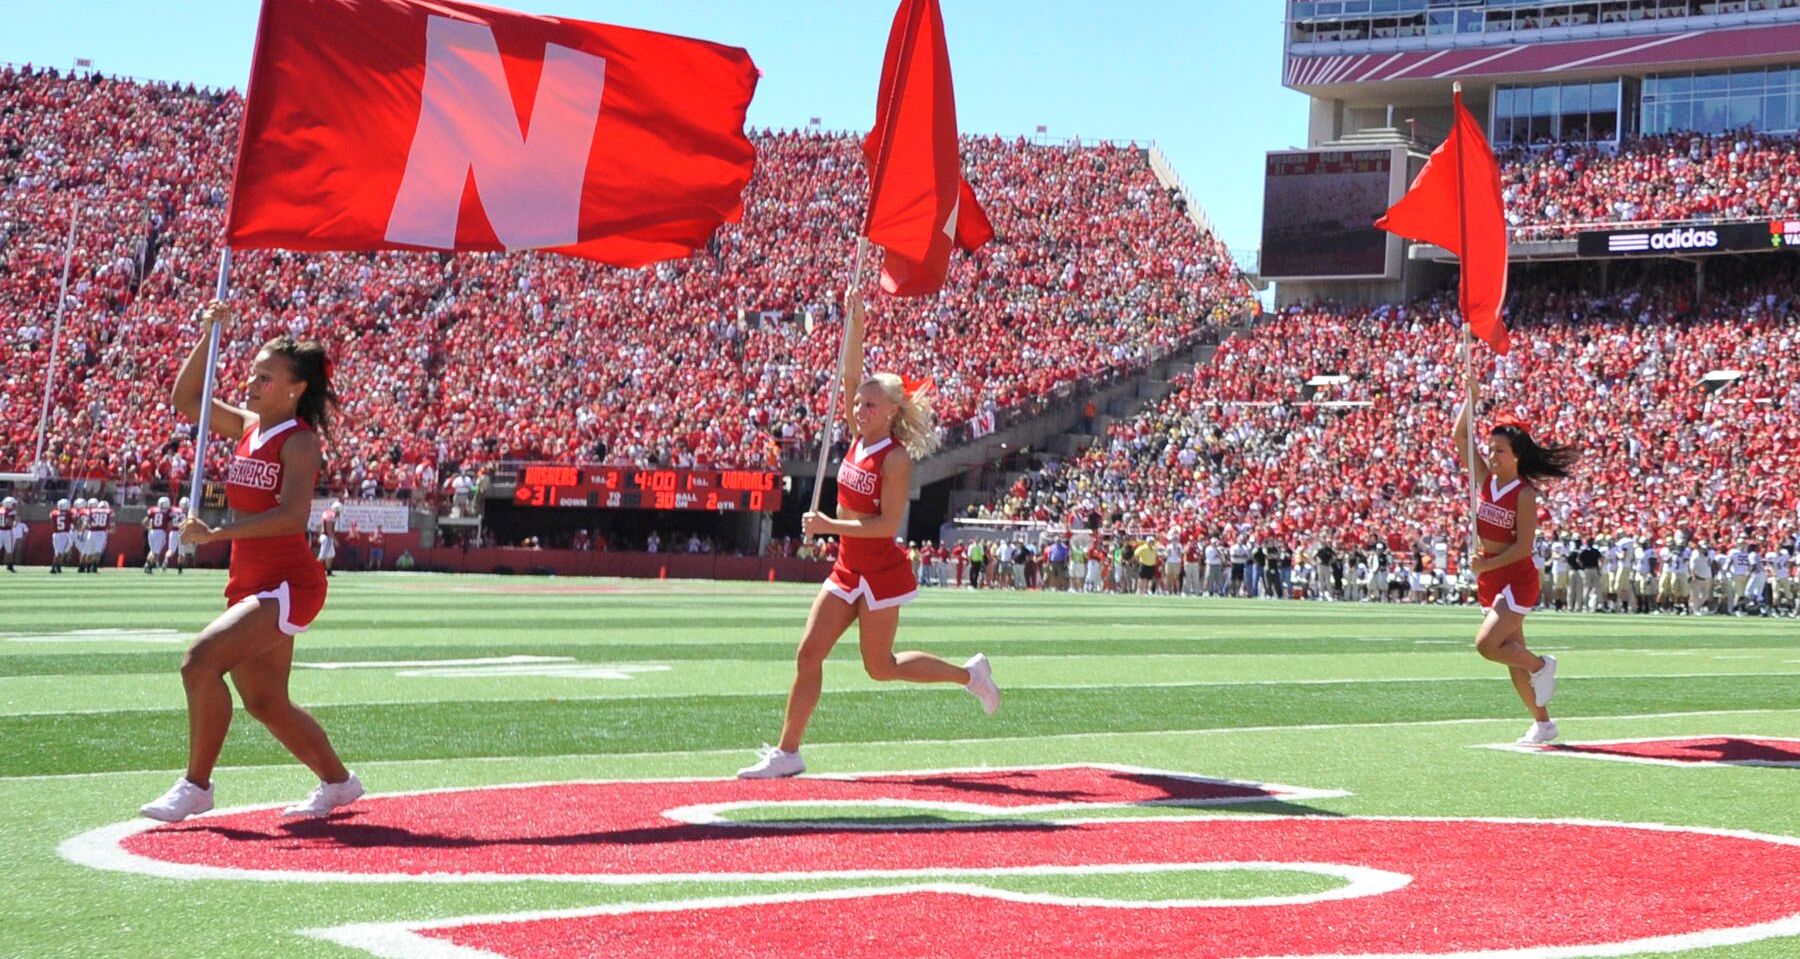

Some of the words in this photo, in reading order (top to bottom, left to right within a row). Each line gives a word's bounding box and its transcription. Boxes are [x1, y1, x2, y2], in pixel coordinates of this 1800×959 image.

[384, 14, 606, 251] N
[1650, 227, 1718, 250] adidas
[227, 455, 281, 491] SKERS
[606, 471, 619, 490] 2
[634, 470, 677, 492] 4:00
[686, 472, 694, 491] 1
[560, 497, 588, 508] DOWN
[655, 491, 676, 510] 30
[674, 500, 689, 509] ON
[675, 492, 698, 502] BALL
[706, 492, 719, 511] 2
[748, 490, 764, 511] 0
